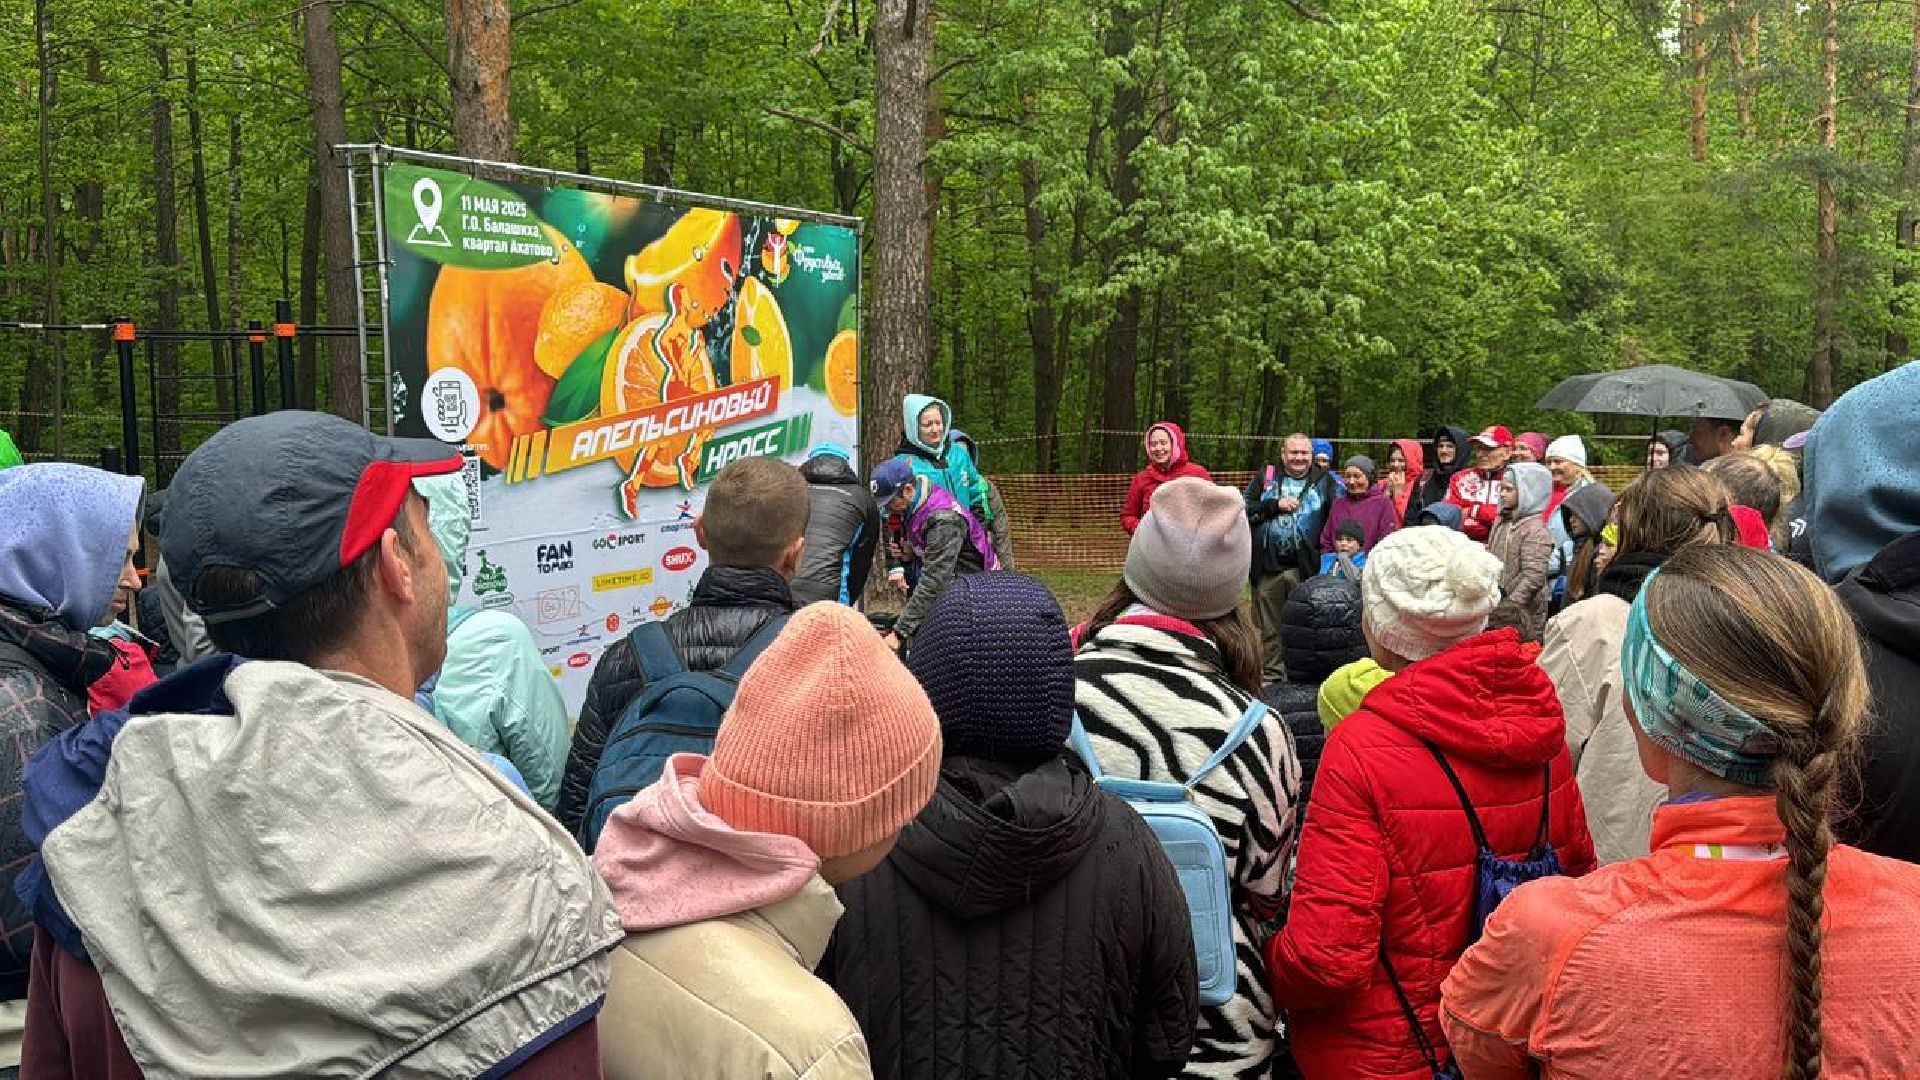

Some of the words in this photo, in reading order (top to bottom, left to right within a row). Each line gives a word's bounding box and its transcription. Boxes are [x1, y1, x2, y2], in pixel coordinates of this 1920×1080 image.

[462, 195, 472, 211] 11
[474, 196, 499, 214] МАЯ
[501, 200, 527, 217] 2025
[483, 217, 542, 240] Балашиха,
[462, 237, 508, 255] квартал
[570, 381, 772, 461] АПЕЛЬСИНОВЫЙ
[537, 540, 573, 562] FAN
